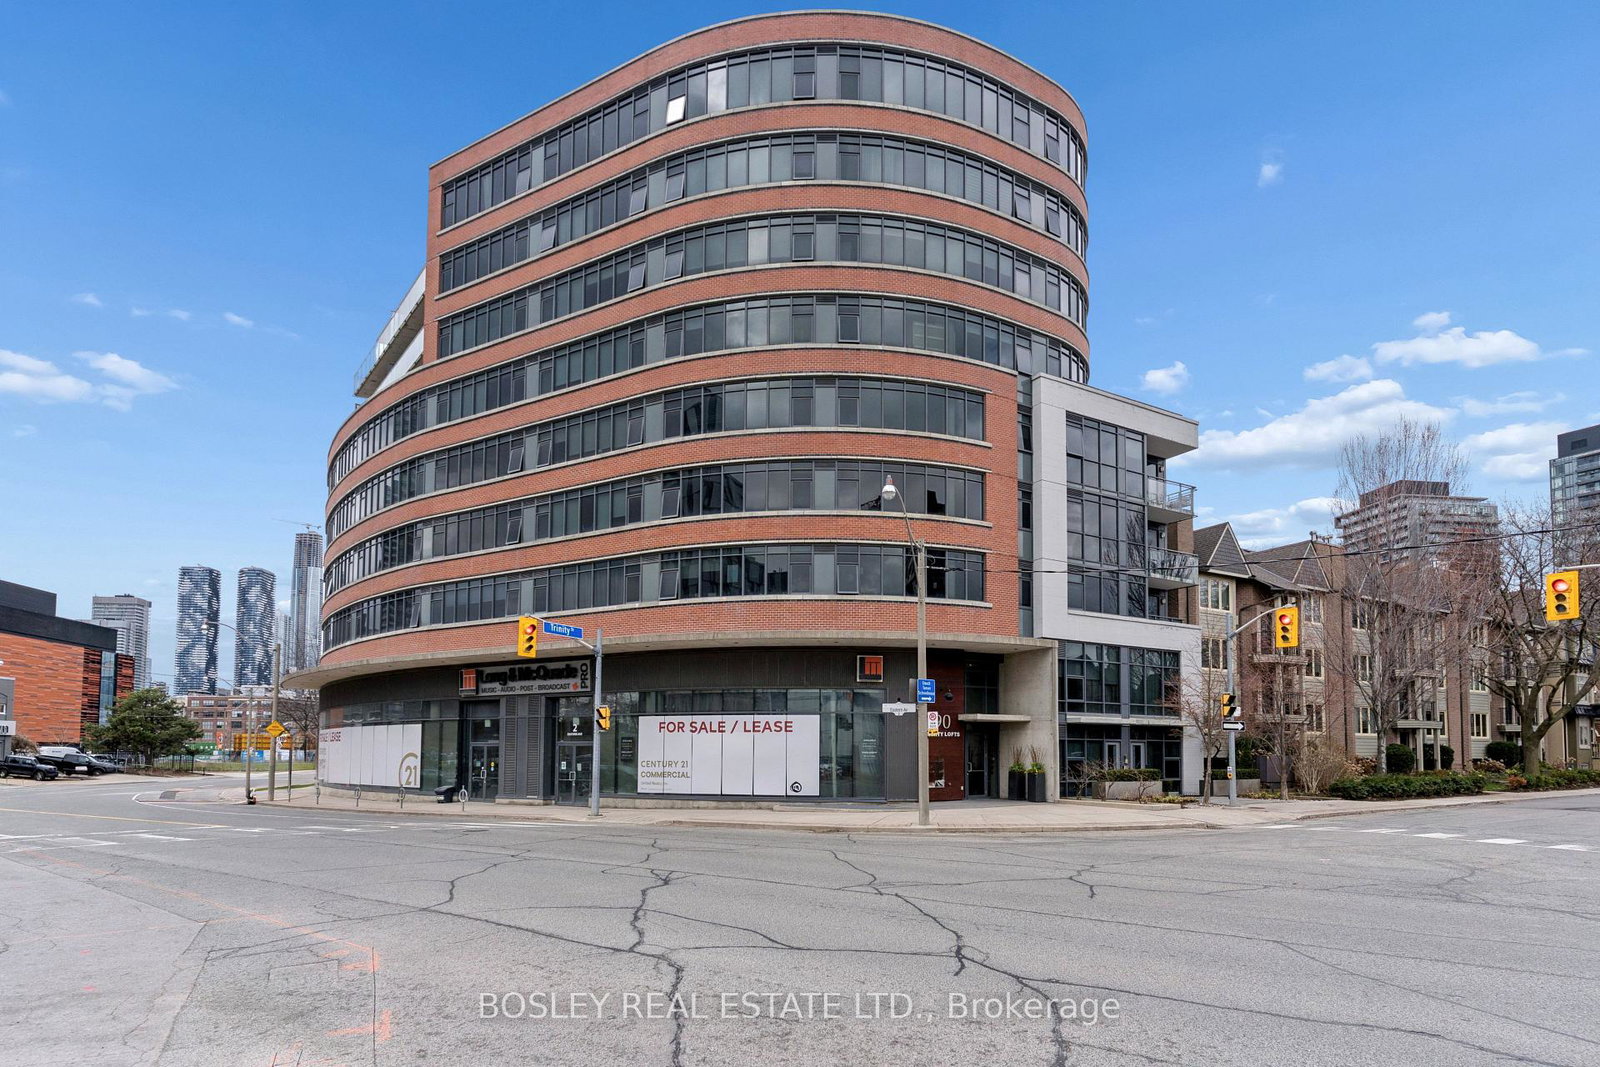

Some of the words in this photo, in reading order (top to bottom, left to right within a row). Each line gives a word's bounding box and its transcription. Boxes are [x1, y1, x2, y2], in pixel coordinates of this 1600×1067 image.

[550, 623, 570, 636] Trinity
[580, 663, 589, 689] PRO
[481, 686, 498, 694] MUSIC
[500, 685, 517, 693] AUDIO
[520, 684, 534, 692] POST
[538, 682, 570, 690] BROADCAST
[572, 723, 578, 732] 2
[658, 721, 685, 733] FOR
[689, 721, 726, 734] SALE
[743, 721, 794, 733] LEASE
[640, 760, 679, 768] CENTURY
[680, 760, 689, 768] 21
[640, 771, 691, 779] COMMERCIAL
